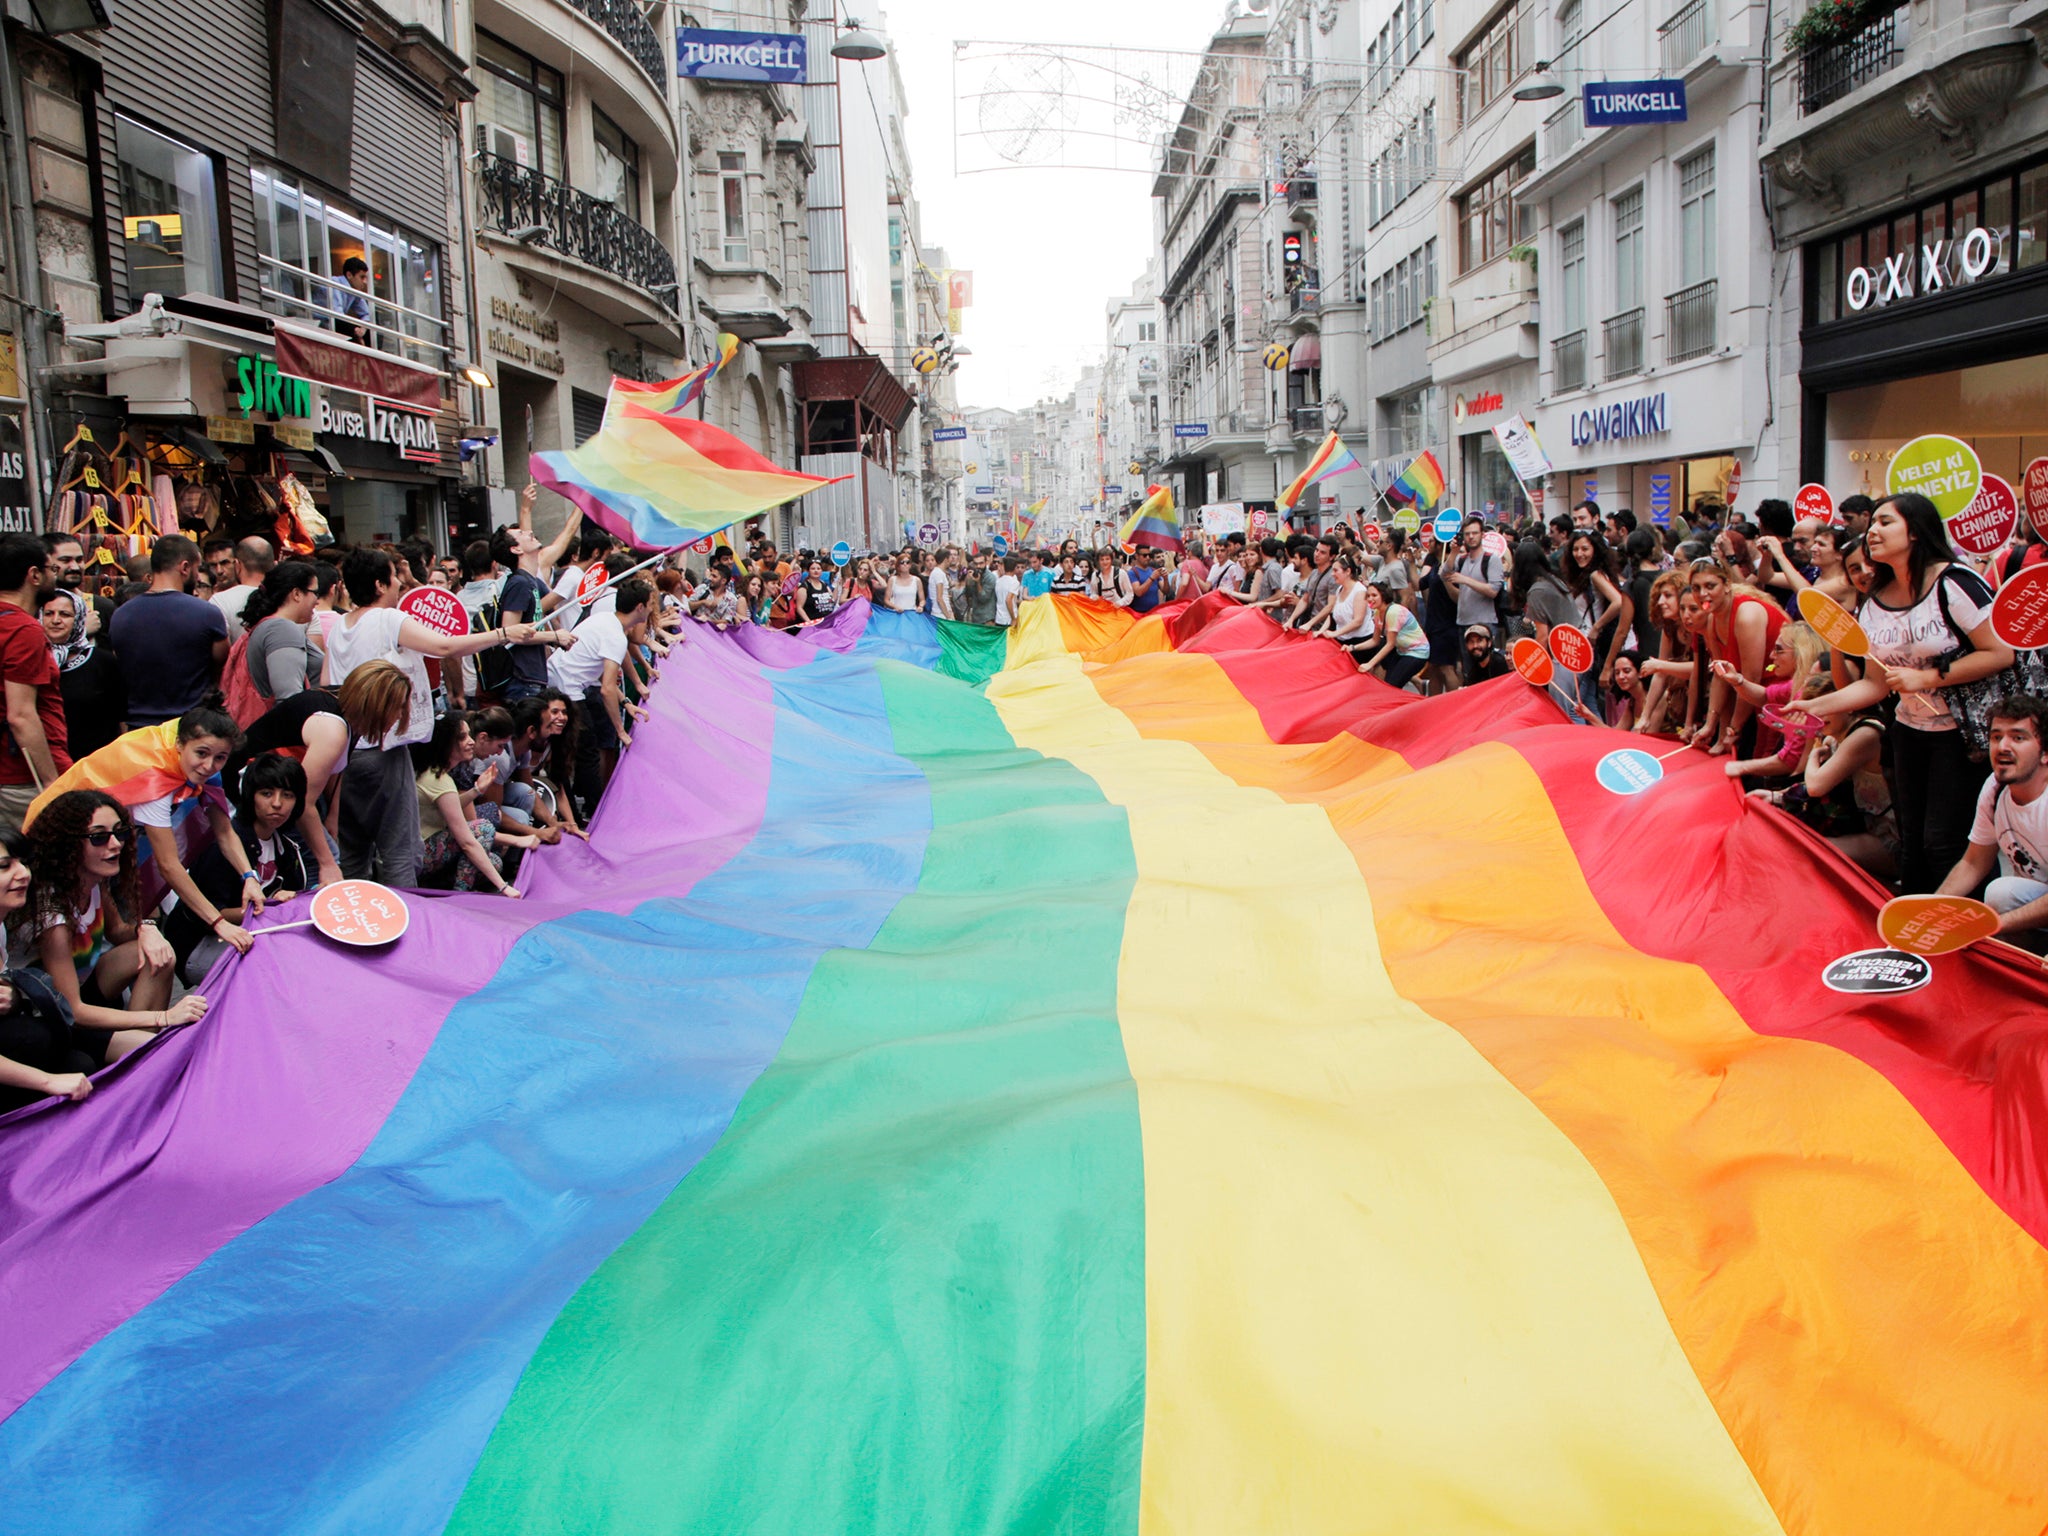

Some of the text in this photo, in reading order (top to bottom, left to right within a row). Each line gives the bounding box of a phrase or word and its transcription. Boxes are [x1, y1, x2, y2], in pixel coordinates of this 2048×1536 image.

[683, 42, 800, 69] TURKCELL
[1590, 92, 1681, 114] TURKCELL
[1847, 227, 1992, 311] OXXO
[1466, 390, 1503, 417] vodafone
[320, 399, 365, 438] Bursa
[1571, 409, 1591, 446] LC
[934, 429, 965, 440] TURKCELL
[1176, 426, 1206, 435] TURKCELL
[87, 470, 97, 485] 15
[1896, 451, 1964, 483] VELEV Kİ
[96, 511, 107, 523] 15
[1954, 506, 2013, 540] LENMEK-
[1972, 528, 2001, 550] TİR!
[99, 551, 110, 562] 15
[411, 597, 462, 631] ÖRGÜT-
[424, 591, 457, 614] ASK
[1557, 629, 1585, 648] DÖN-
[370, 897, 396, 920] نحن
[1896, 909, 1936, 941] VELEV
[1910, 907, 1987, 951] İBNEYİZ
[1829, 972, 1877, 982] DEVLET
[1847, 966, 1907, 977] HESAP
